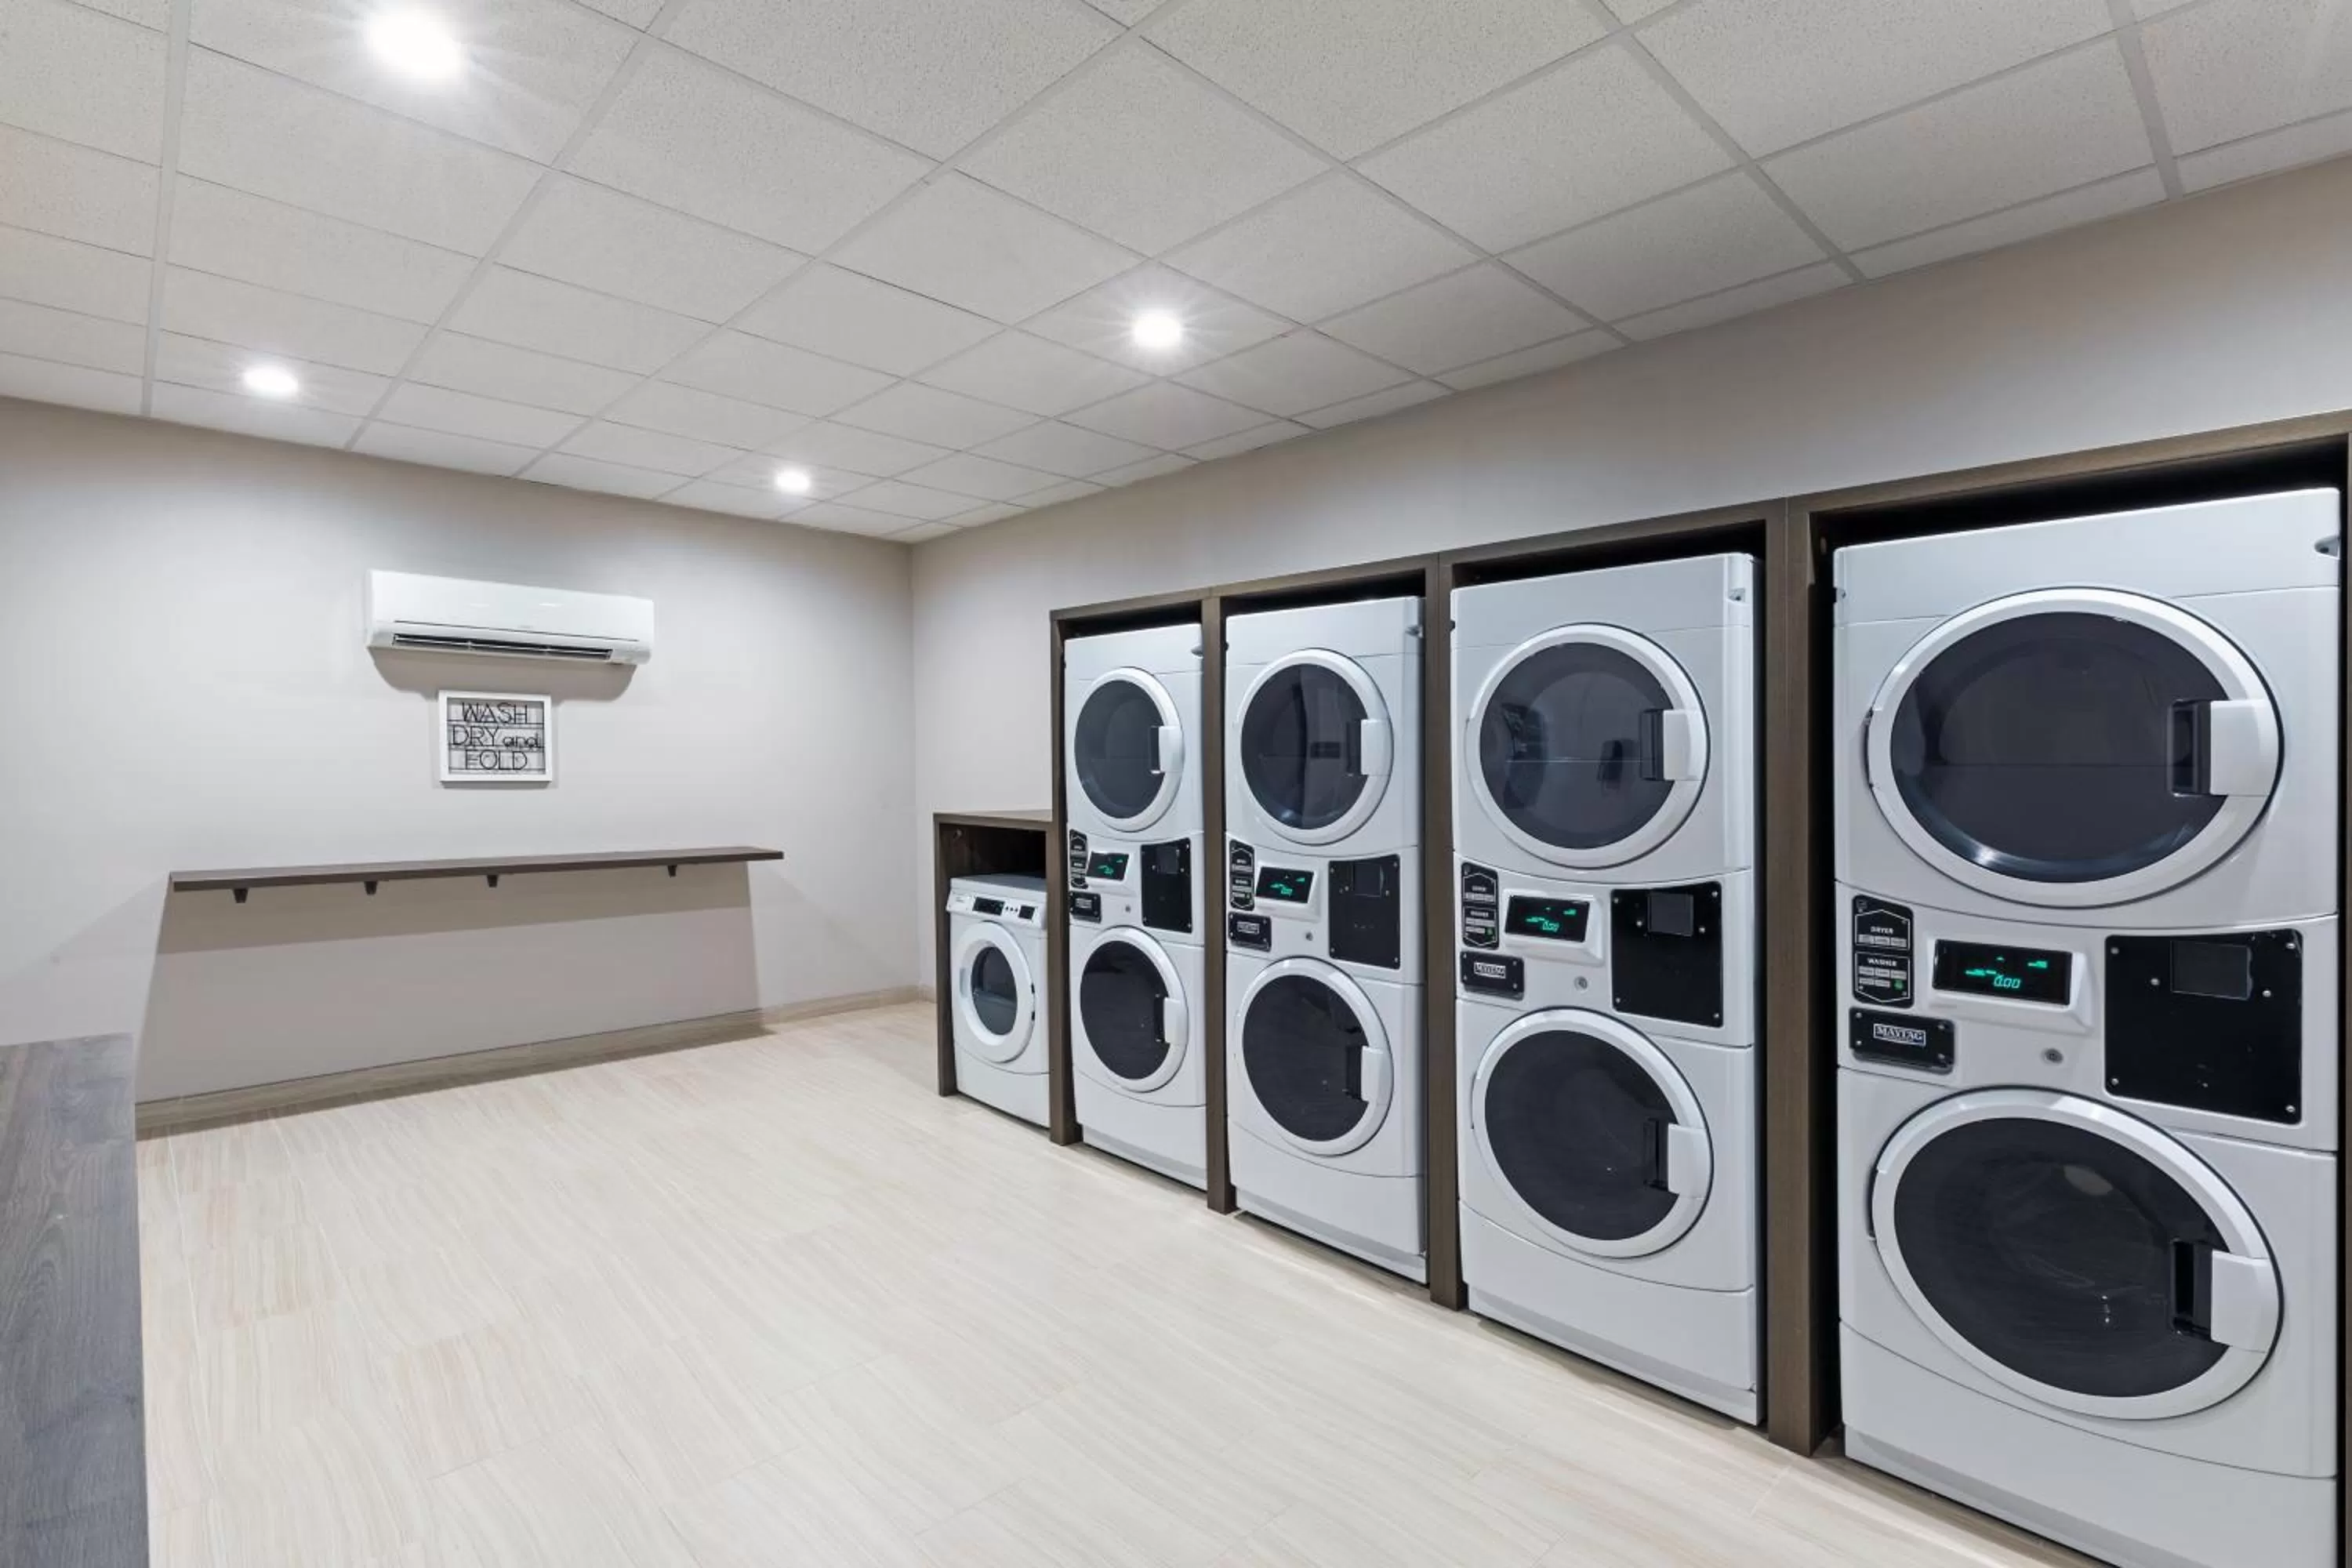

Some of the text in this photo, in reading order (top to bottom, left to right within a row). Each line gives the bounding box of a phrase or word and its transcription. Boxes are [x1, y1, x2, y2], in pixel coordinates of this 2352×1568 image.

[462, 702, 527, 724] WASH
[452, 725, 539, 748] DRY and
[466, 750, 528, 770] FOLD
[1876, 1025, 1923, 1041] MAYTAG
